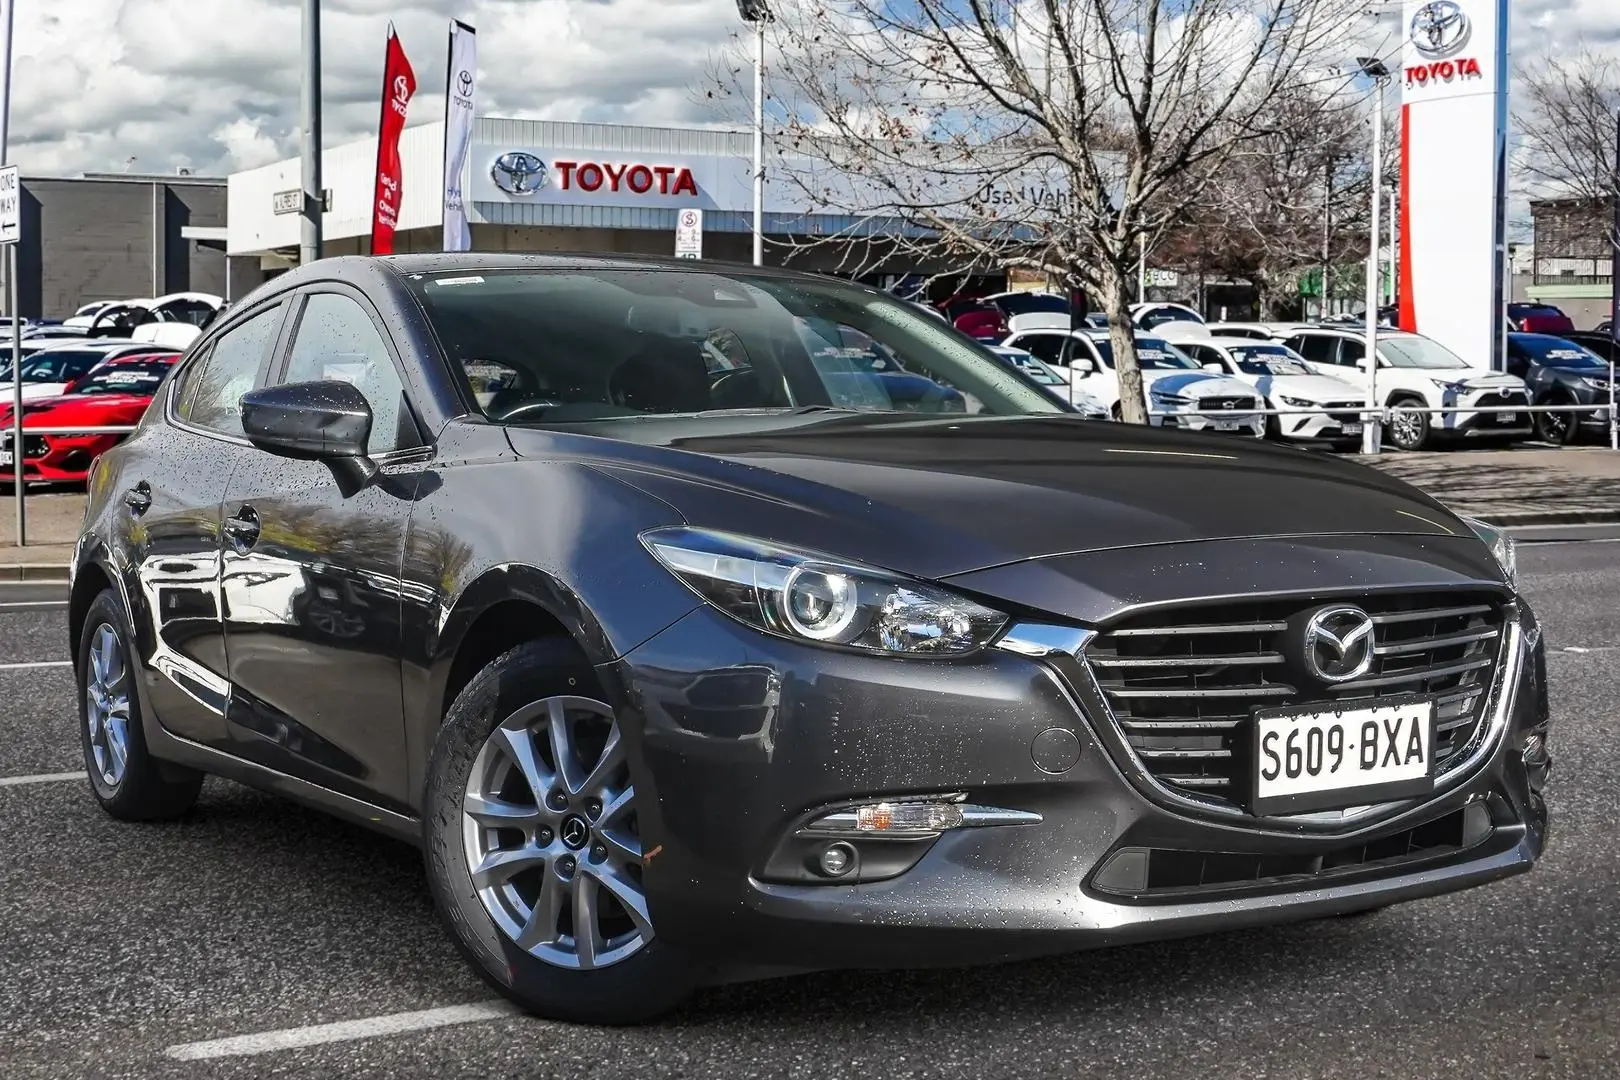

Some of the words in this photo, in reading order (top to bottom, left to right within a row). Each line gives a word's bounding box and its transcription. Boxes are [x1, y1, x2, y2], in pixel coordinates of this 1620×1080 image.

[1404, 58, 1481, 83] TOYOTA
[1, 173, 15, 191] ONE
[555, 161, 698, 196] TOYOTA
[0, 197, 16, 214] WAY
